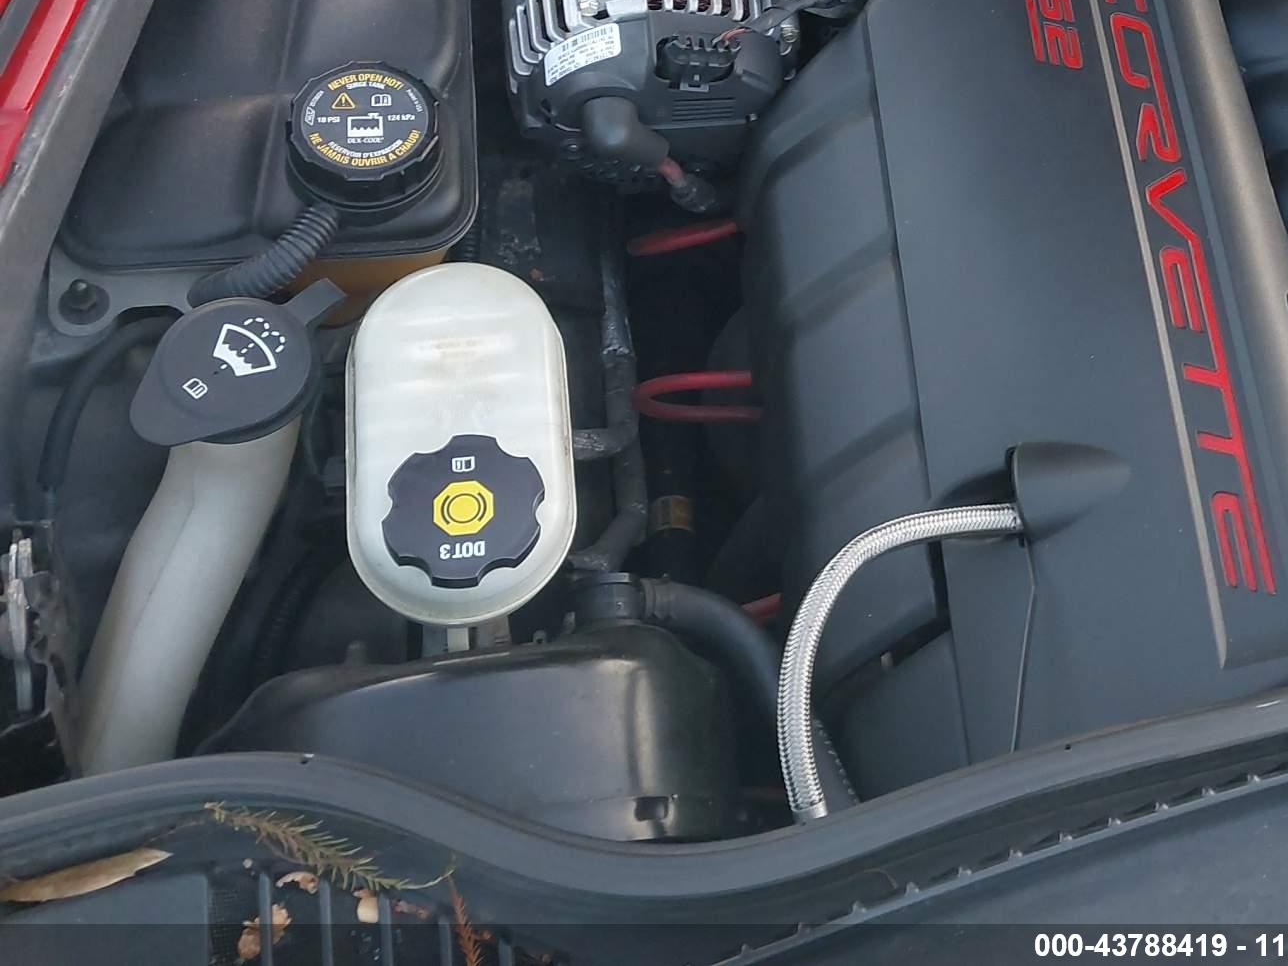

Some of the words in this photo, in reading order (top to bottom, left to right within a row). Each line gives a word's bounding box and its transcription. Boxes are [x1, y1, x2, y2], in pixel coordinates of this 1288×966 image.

[328, 75, 357, 91] NEVER
[358, 74, 382, 83] OPEN
[383, 76, 405, 91] HOT!
[309, 132, 322, 145] NE
[317, 143, 350, 164] JAMAIS
[351, 156, 388, 167] OUVRIR
[395, 129, 422, 155] CHAUD!
[439, 543, 451, 560] 3
[451, 540, 486, 559] DOT
